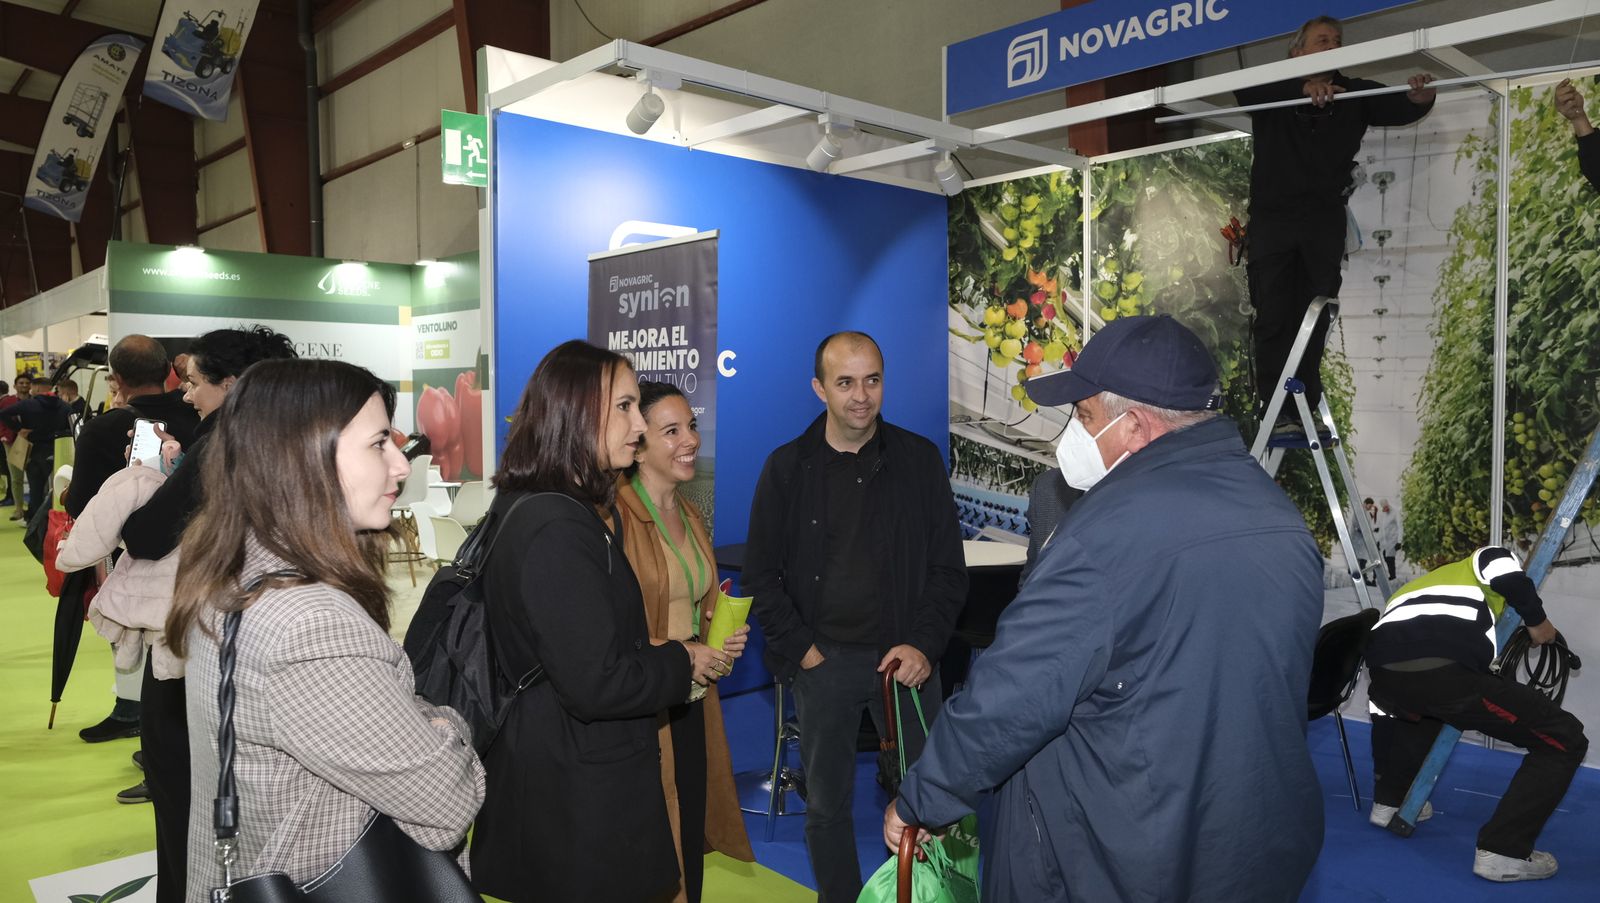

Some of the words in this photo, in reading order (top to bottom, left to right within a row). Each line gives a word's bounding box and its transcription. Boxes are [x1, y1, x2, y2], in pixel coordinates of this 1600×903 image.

[1059, 0, 1230, 62] NOVAGRIC
[161, 70, 219, 101] TIZONA
[36, 189, 77, 209] TIZONA
[619, 274, 653, 287] NOVAGRIC
[417, 320, 458, 334] VENTOLUNO
[608, 326, 670, 351] MEJORA
[671, 325, 689, 346] EL
[293, 342, 344, 357] GENE
[619, 348, 700, 372] DIMIENTO
[690, 406, 705, 417] egar
